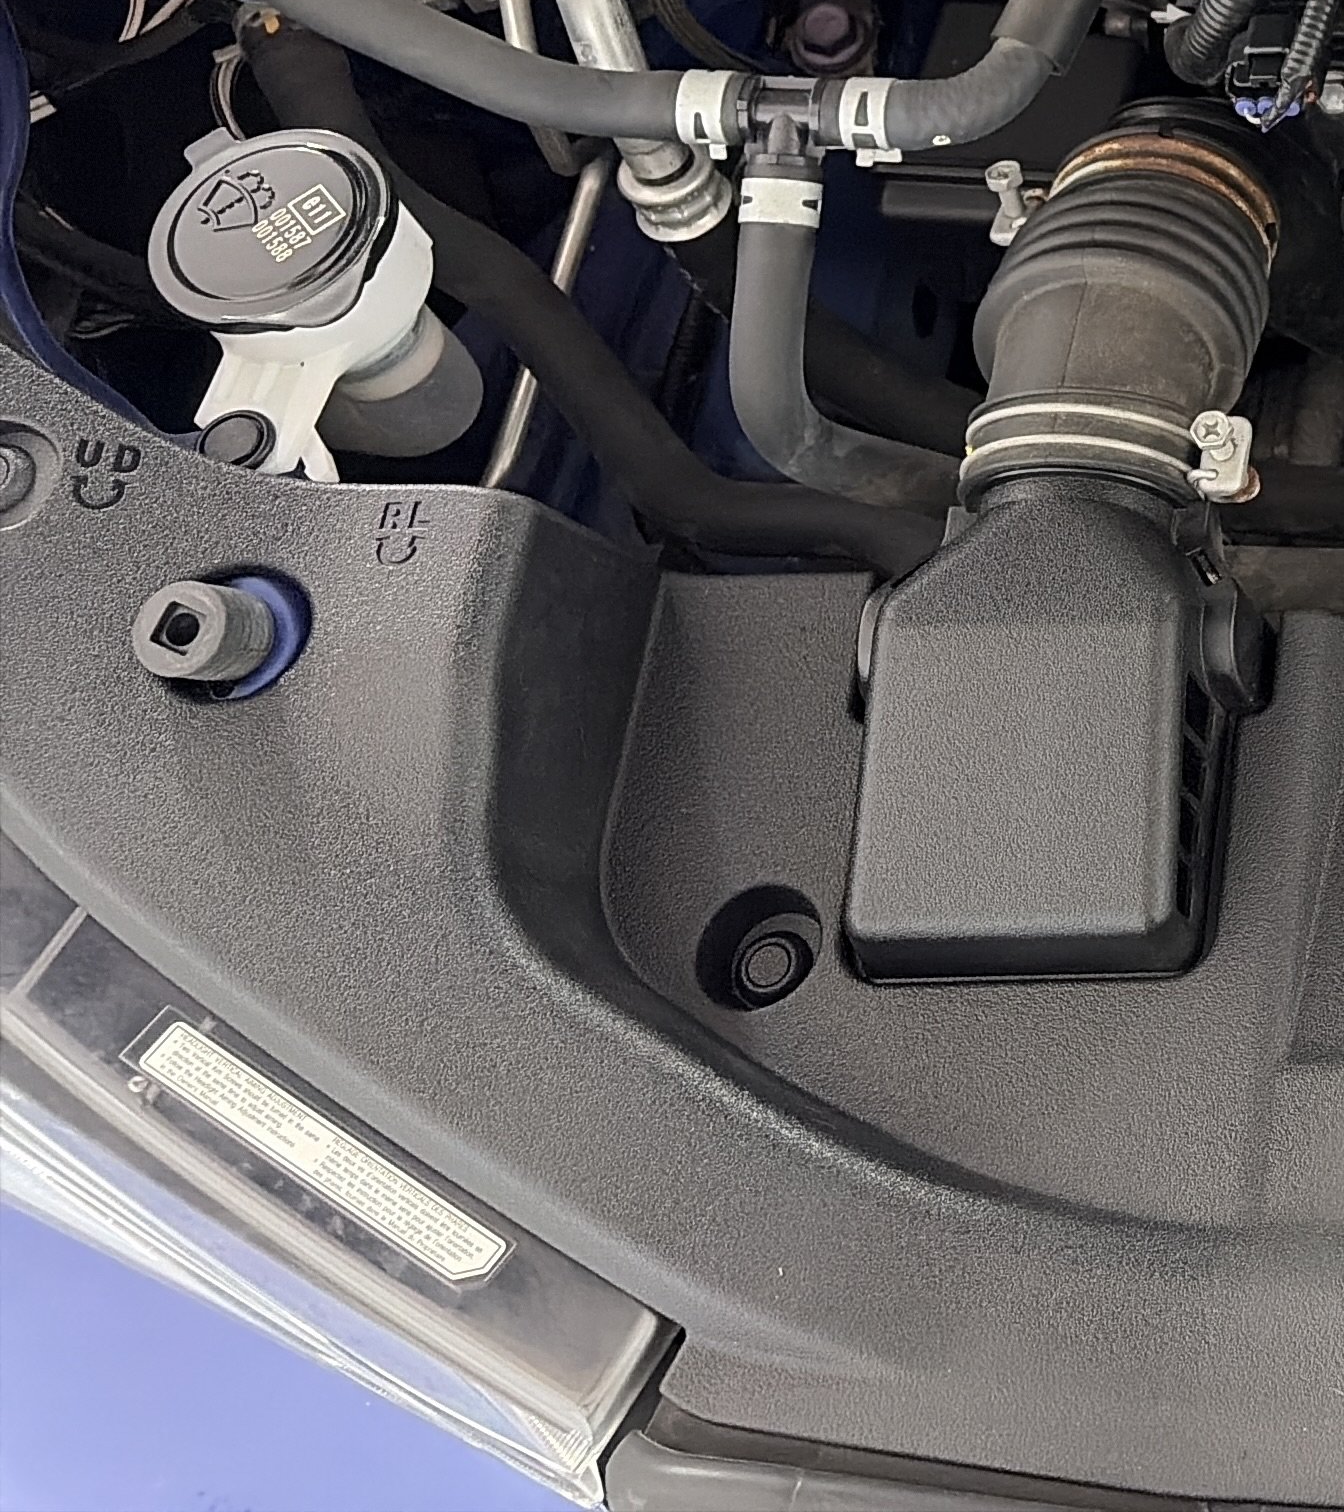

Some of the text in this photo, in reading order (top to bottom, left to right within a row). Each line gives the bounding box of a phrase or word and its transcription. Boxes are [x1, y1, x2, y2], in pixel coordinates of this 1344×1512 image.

[270, 206, 312, 251] 001587
[302, 194, 333, 229] e11
[251, 219, 295, 263] 001588
